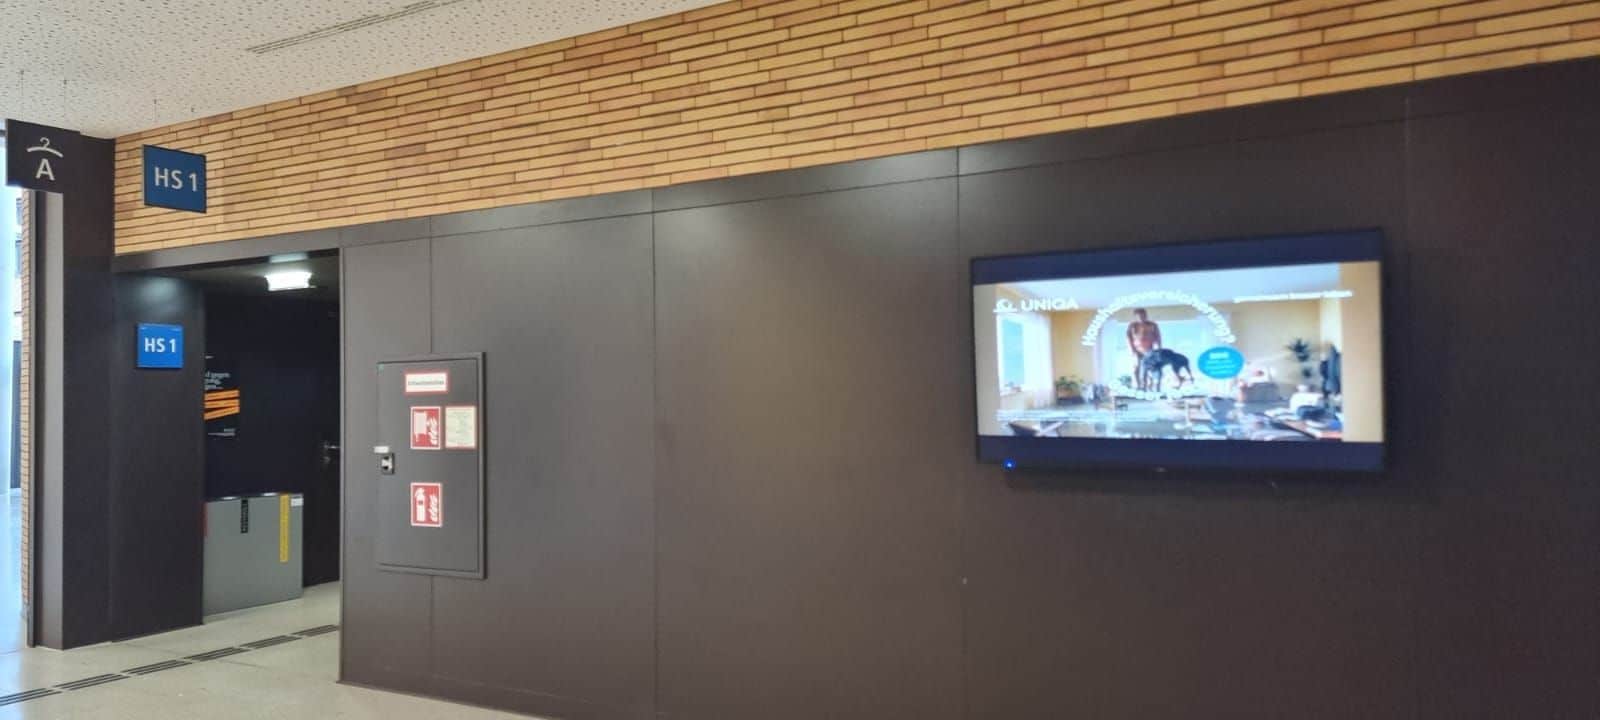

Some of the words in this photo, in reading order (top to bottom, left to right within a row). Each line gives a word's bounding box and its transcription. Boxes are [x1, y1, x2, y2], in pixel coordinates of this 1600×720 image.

[35, 158, 56, 181] A
[154, 167, 183, 190] HS
[188, 172, 198, 192] 1
[144, 337, 166, 353] HS
[169, 338, 176, 353] 1
